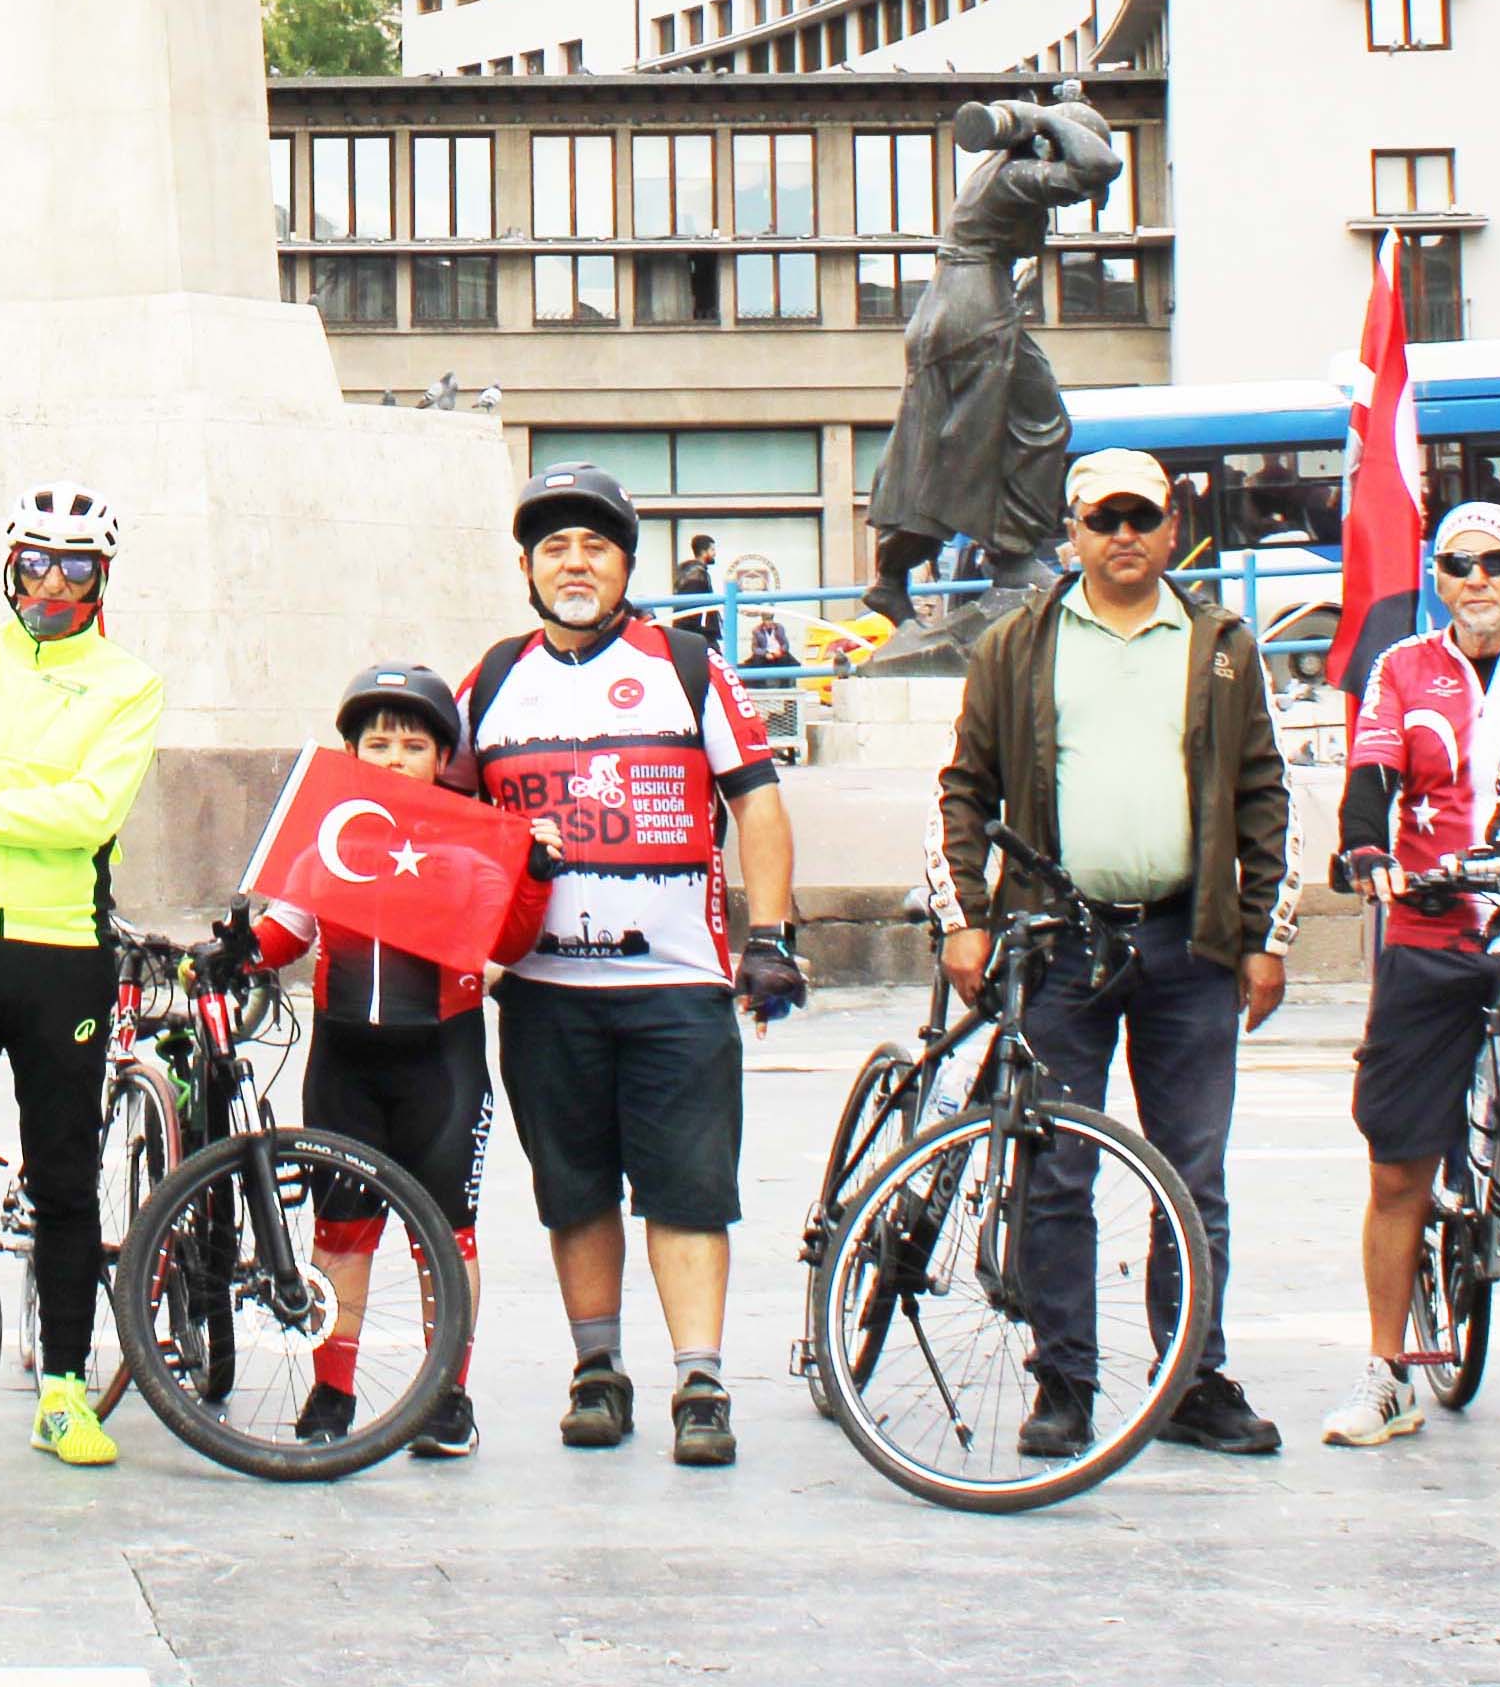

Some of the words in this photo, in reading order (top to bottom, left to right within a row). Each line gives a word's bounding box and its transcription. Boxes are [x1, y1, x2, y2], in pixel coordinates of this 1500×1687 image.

[630, 765, 685, 779] ANKARA
[653, 796, 685, 812] DOĞA
[635, 814, 694, 828] SPORLARI
[557, 945, 625, 957] ANKARA
[463, 1091, 495, 1210] TÜRKİYE
